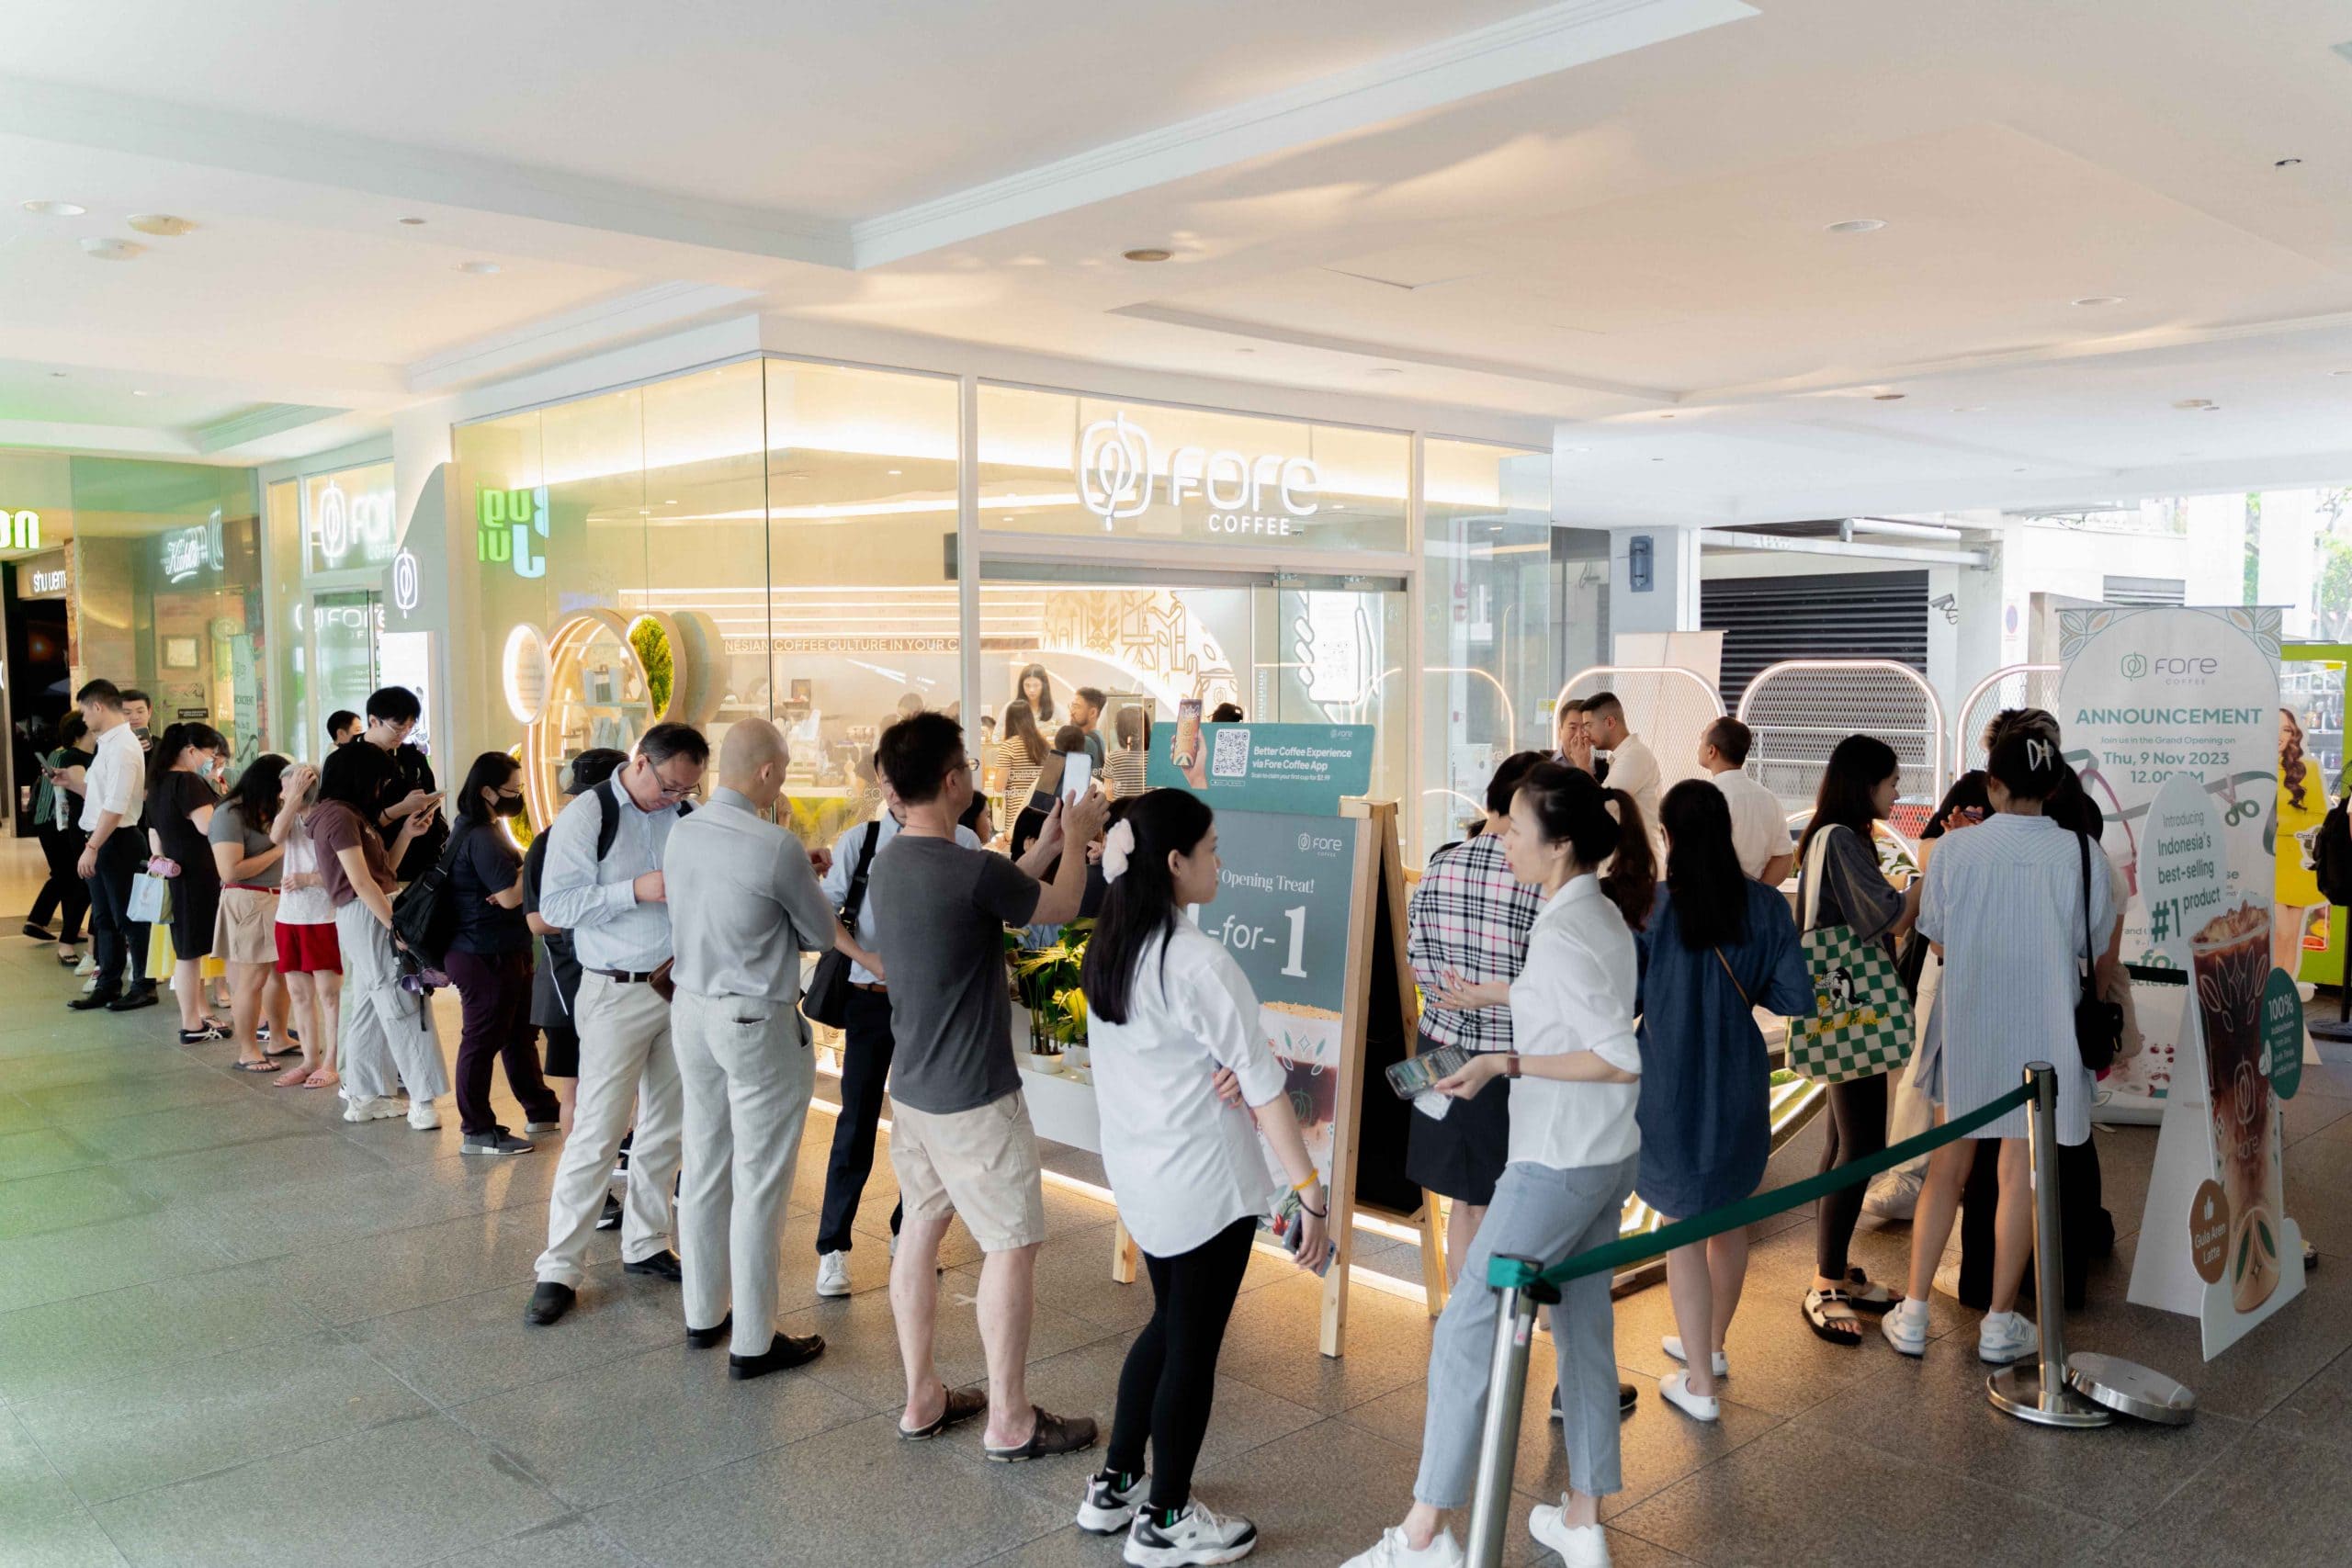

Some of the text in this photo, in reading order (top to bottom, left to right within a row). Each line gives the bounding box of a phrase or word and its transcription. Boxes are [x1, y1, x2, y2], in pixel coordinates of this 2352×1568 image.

[1208, 513, 1290, 536] COFFEE
[774, 638, 825, 651] COFFEE
[828, 638, 887, 651] CULTURE
[889, 638, 903, 651] IN
[907, 638, 944, 651] YOUR
[2075, 707, 2264, 726] ANNOUNCEMENT
[2101, 736, 2118, 744] Join
[2131, 736, 2139, 744] in
[2140, 736, 2154, 744] the
[2154, 736, 2183, 744] Grand
[2184, 736, 2223, 746] Opening
[1253, 746, 1352, 759] Better Coffee Experience
[2103, 751, 2230, 766] Thu, 9 Nov 2023
[1252, 759, 1329, 773] via Fore Coffee App
[2163, 810, 2205, 828] Introducing
[2157, 831, 2211, 856] Indonesia's
[1222, 869, 1315, 893] Opening Treat!
[2157, 858, 2214, 884] best-selling
[2183, 887, 2221, 914] product
[2151, 897, 2181, 943] #1
[2268, 992, 2294, 1021] 100%
